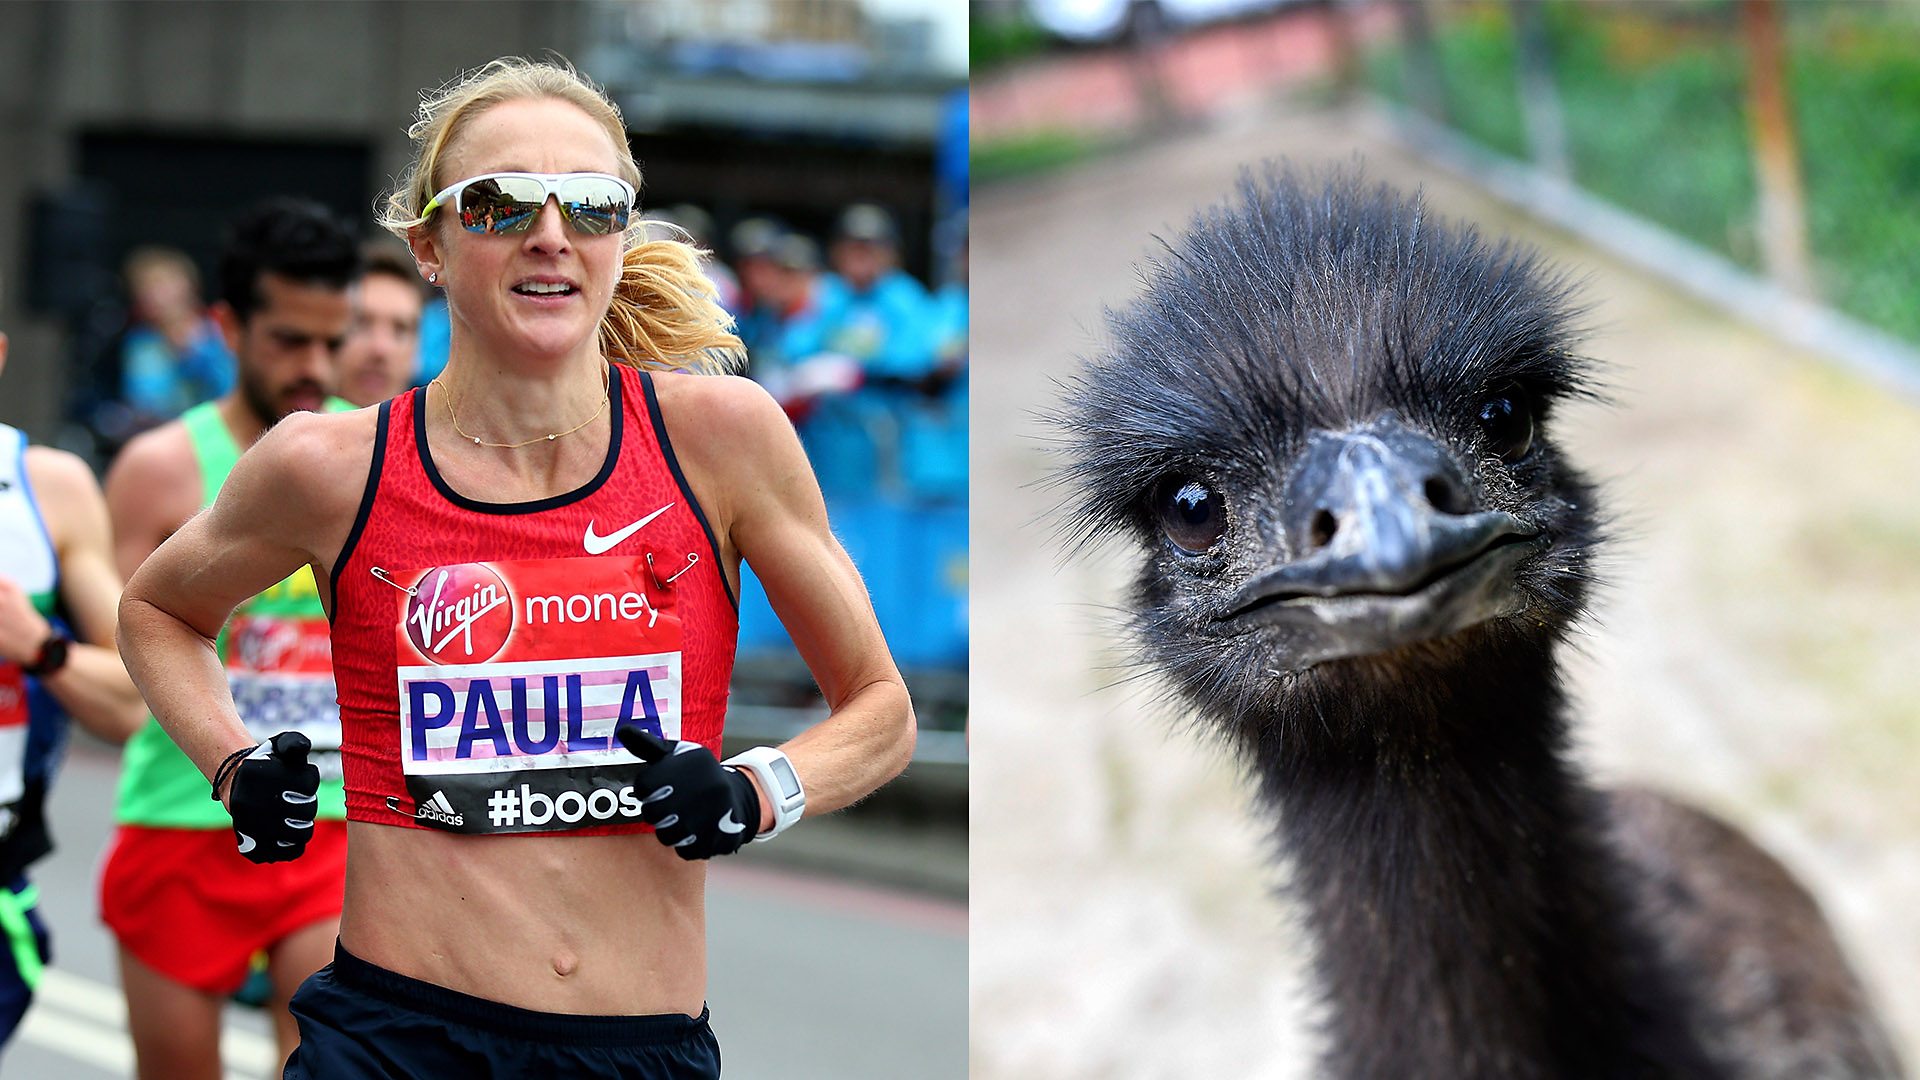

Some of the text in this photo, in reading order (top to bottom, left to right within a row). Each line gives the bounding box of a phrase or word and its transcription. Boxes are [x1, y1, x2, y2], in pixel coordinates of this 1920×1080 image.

[410, 570, 658, 655] Virgin money
[408, 670, 665, 761] PAULA
[418, 806, 464, 826] adidas
